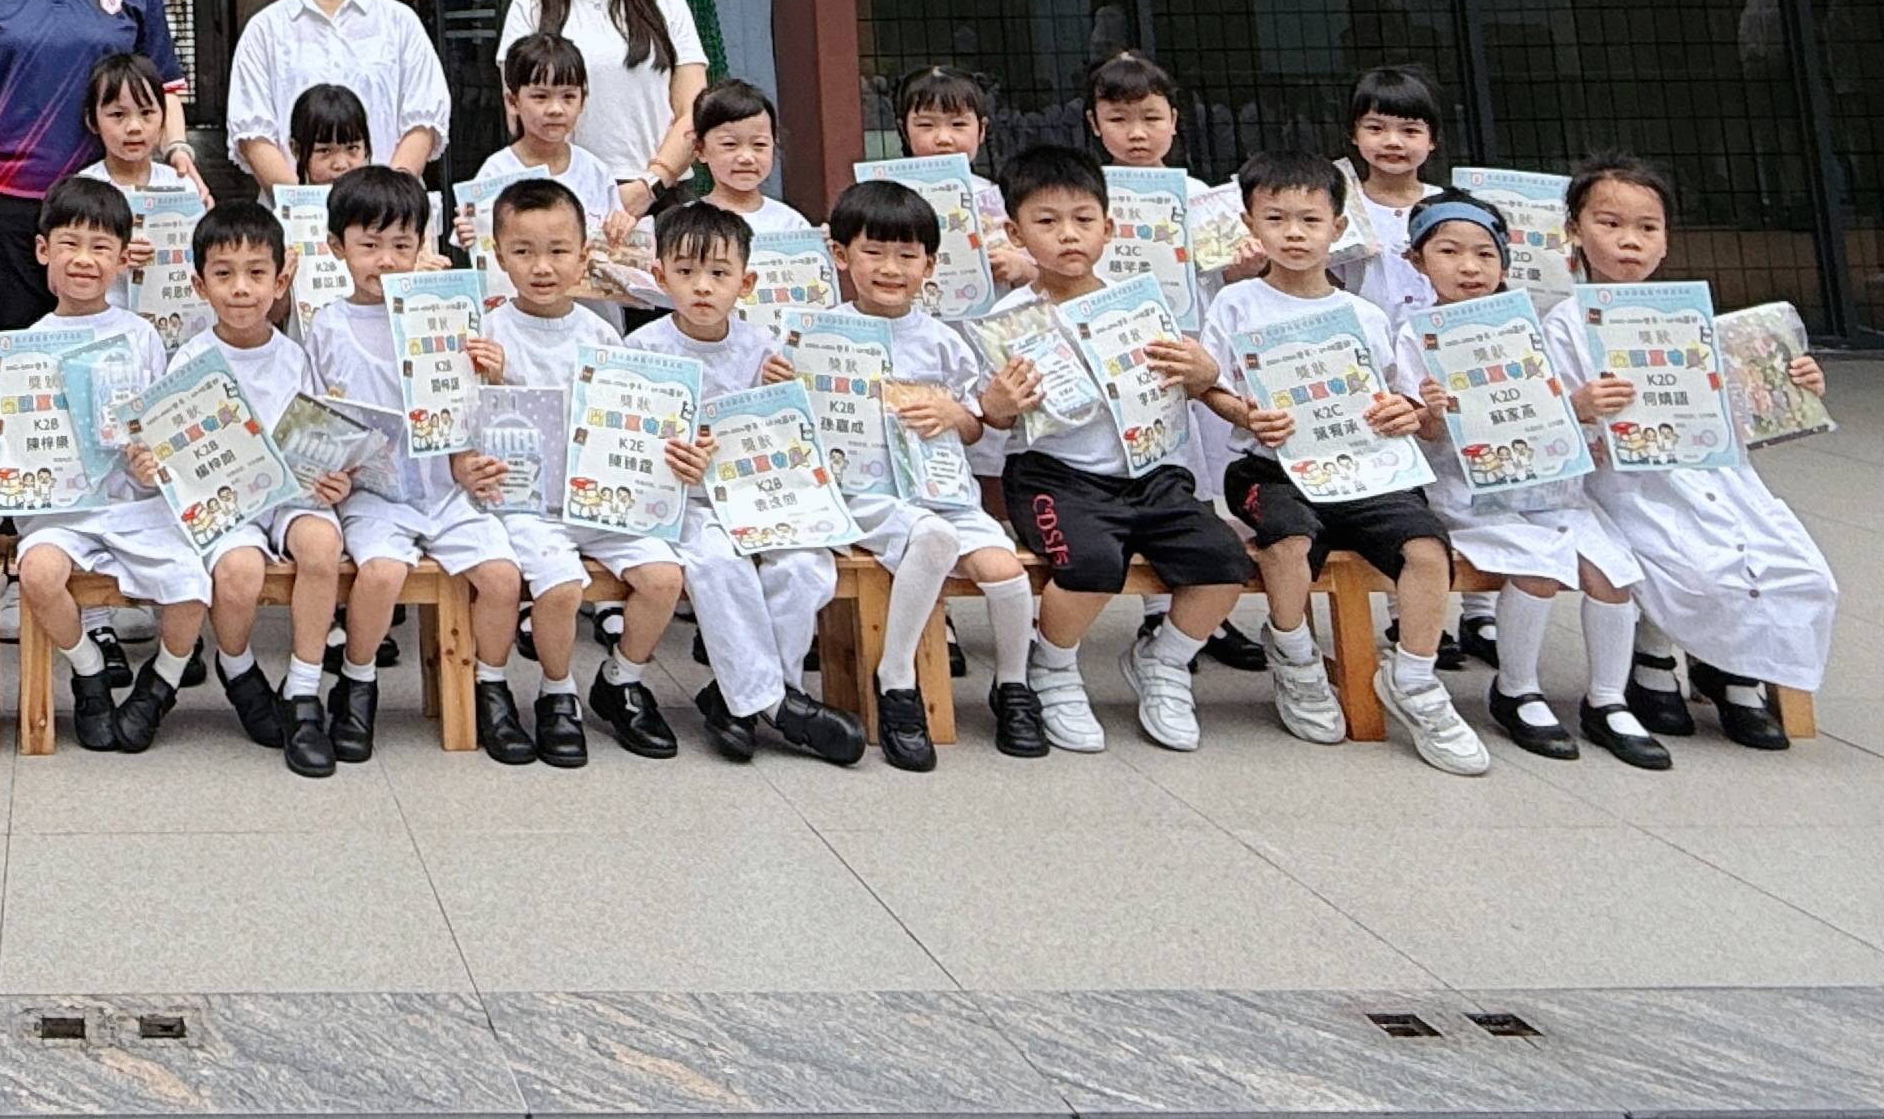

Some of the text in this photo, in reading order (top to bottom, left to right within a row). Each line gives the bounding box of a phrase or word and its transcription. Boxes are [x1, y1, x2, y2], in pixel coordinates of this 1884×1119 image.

[1646, 374, 1676, 386] K2D
[1489, 388, 1520, 404] K2D
[1313, 404, 1344, 420] K2C
[34, 417, 59, 431] K2B
[619, 437, 645, 453] K2E
[755, 476, 784, 493] K2B
